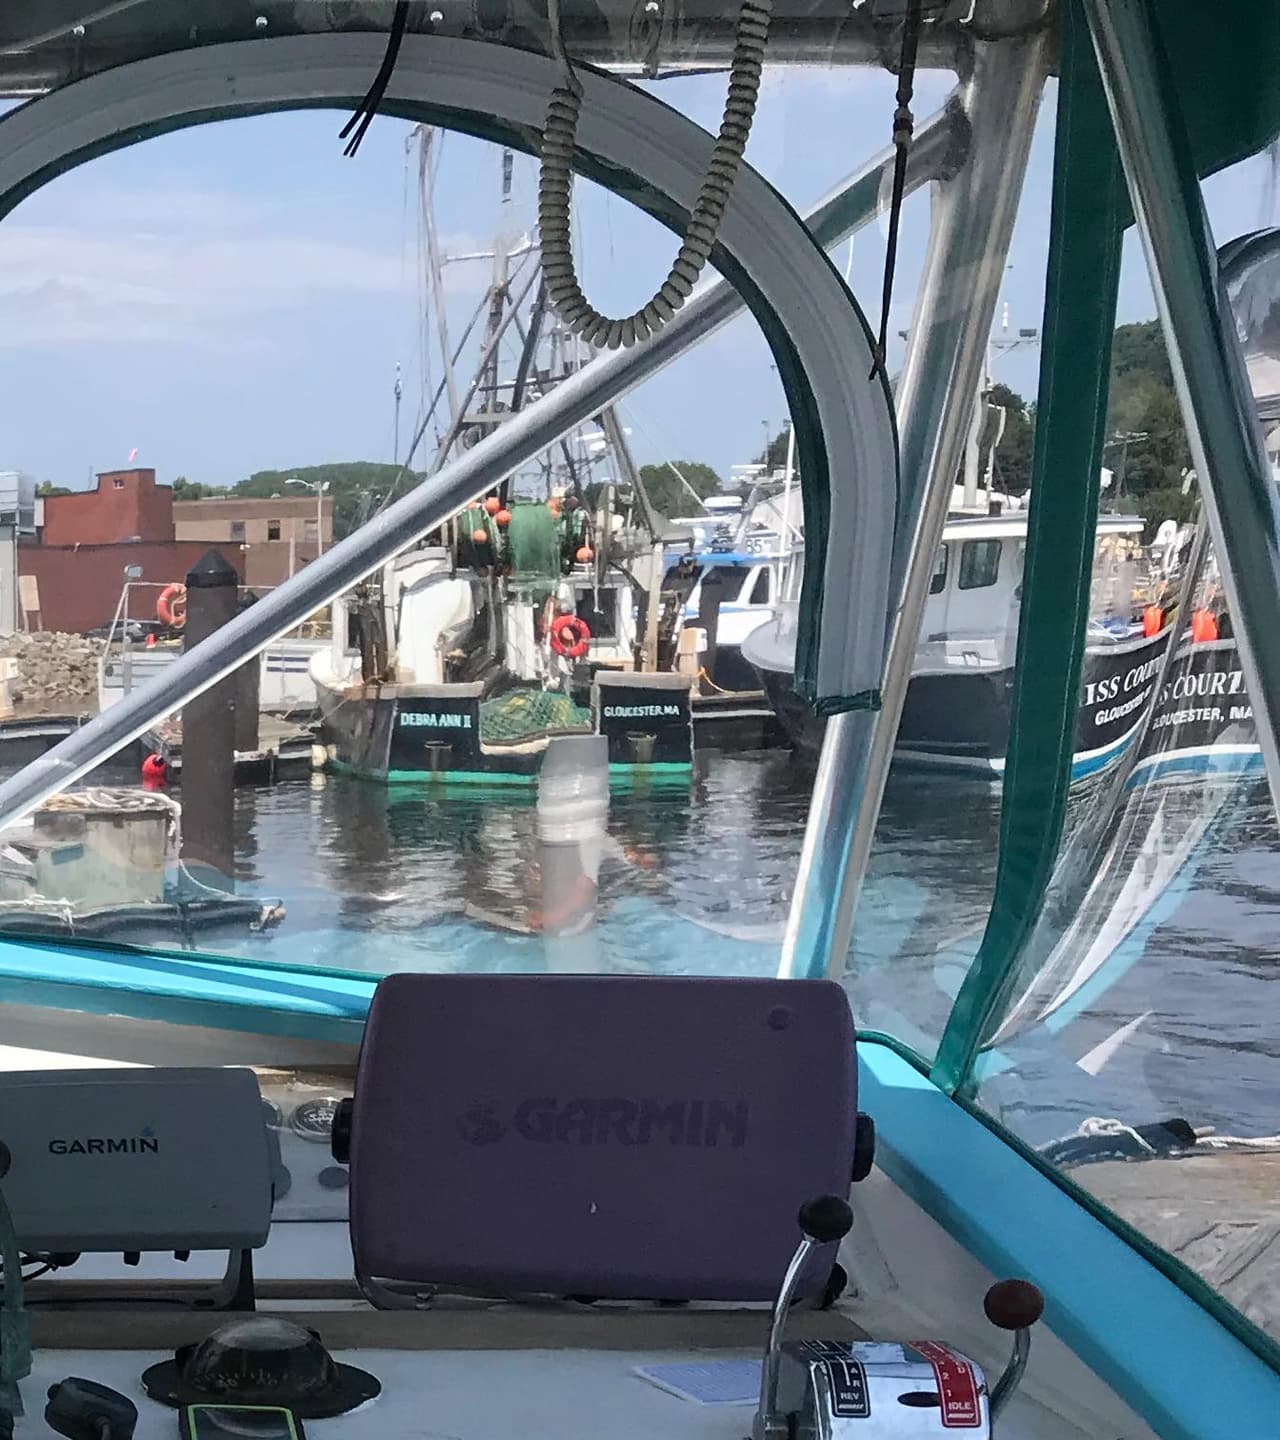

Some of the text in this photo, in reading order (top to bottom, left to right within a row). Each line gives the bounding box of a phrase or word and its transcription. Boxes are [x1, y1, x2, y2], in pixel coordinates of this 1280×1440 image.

[400, 712, 438, 727] DEBRA
[439, 713, 462, 727] ANN
[514, 1099, 749, 1146] GARMIN
[48, 1138, 159, 1155] GARMIN
[840, 1392, 860, 1400] REV
[948, 1401, 972, 1411] IDLE
